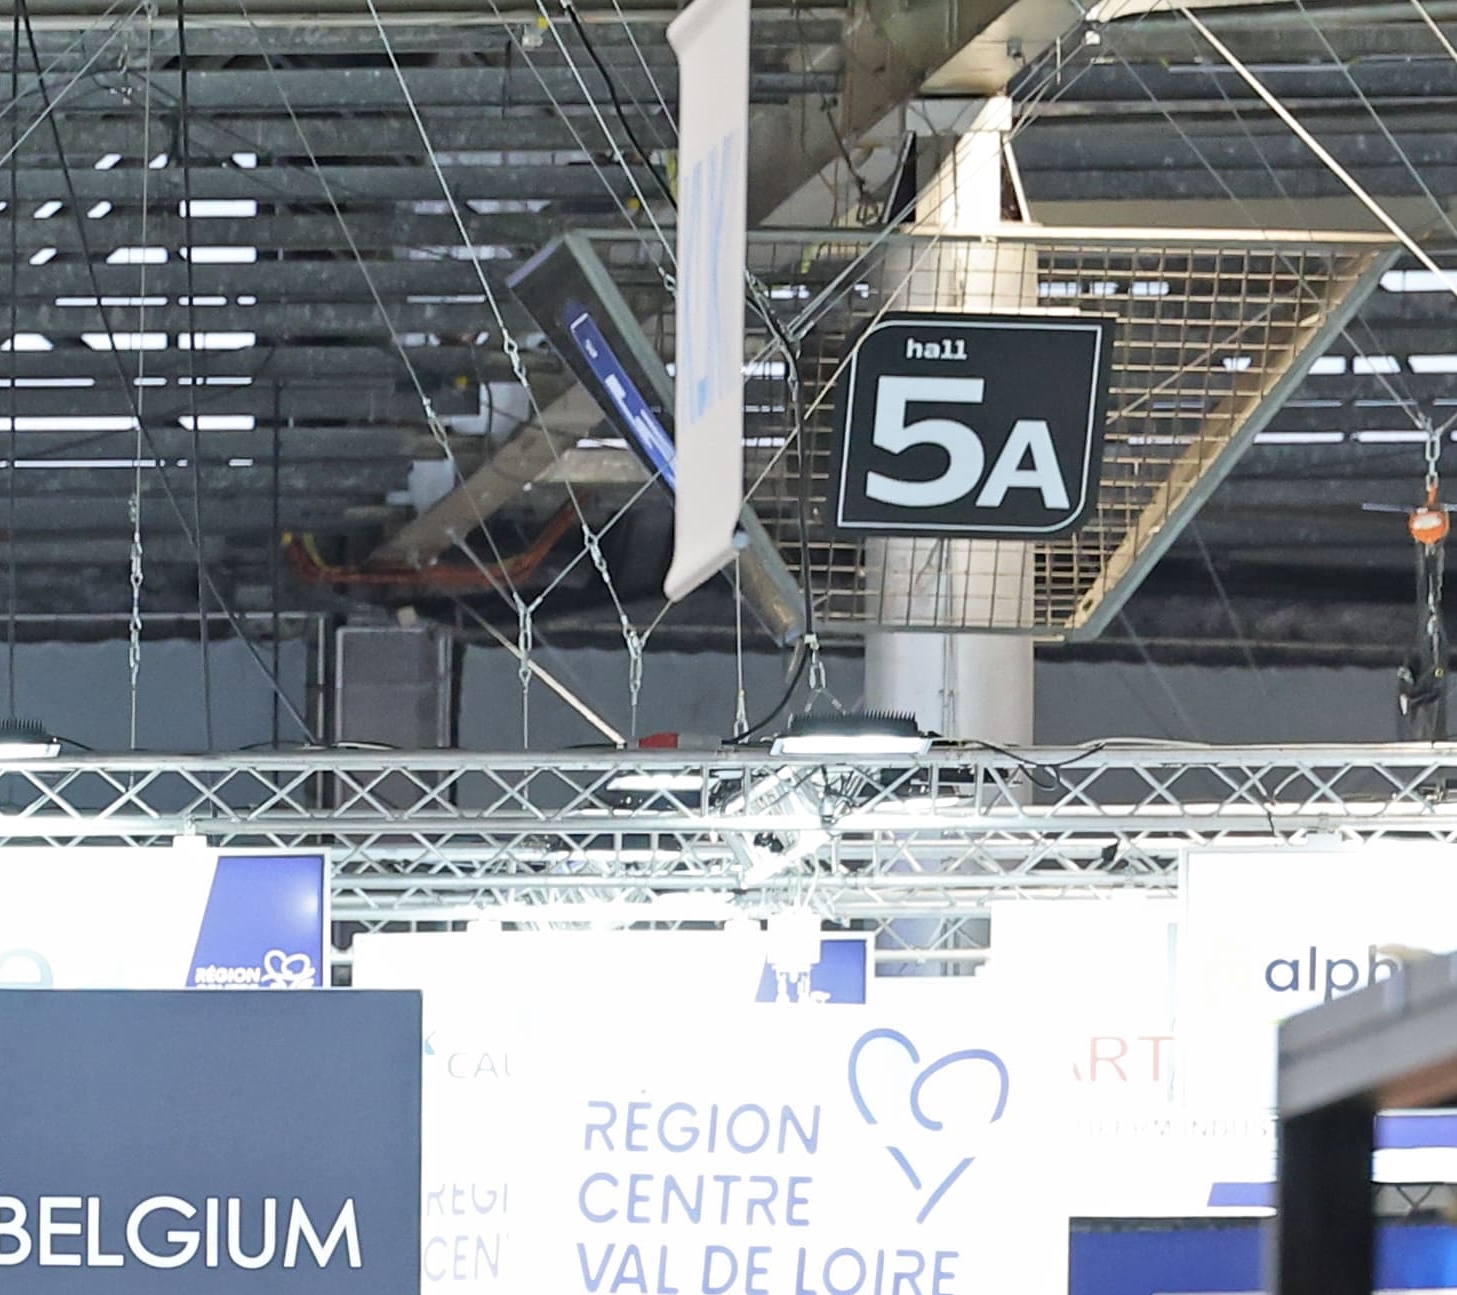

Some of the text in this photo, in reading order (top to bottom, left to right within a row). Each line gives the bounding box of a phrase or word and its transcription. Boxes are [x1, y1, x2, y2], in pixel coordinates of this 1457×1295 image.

[906, 337, 967, 361] hall
[865, 375, 1071, 510] 5A
[578, 1172, 814, 1227] CENTRE
[576, 1242, 678, 1295] VAL
